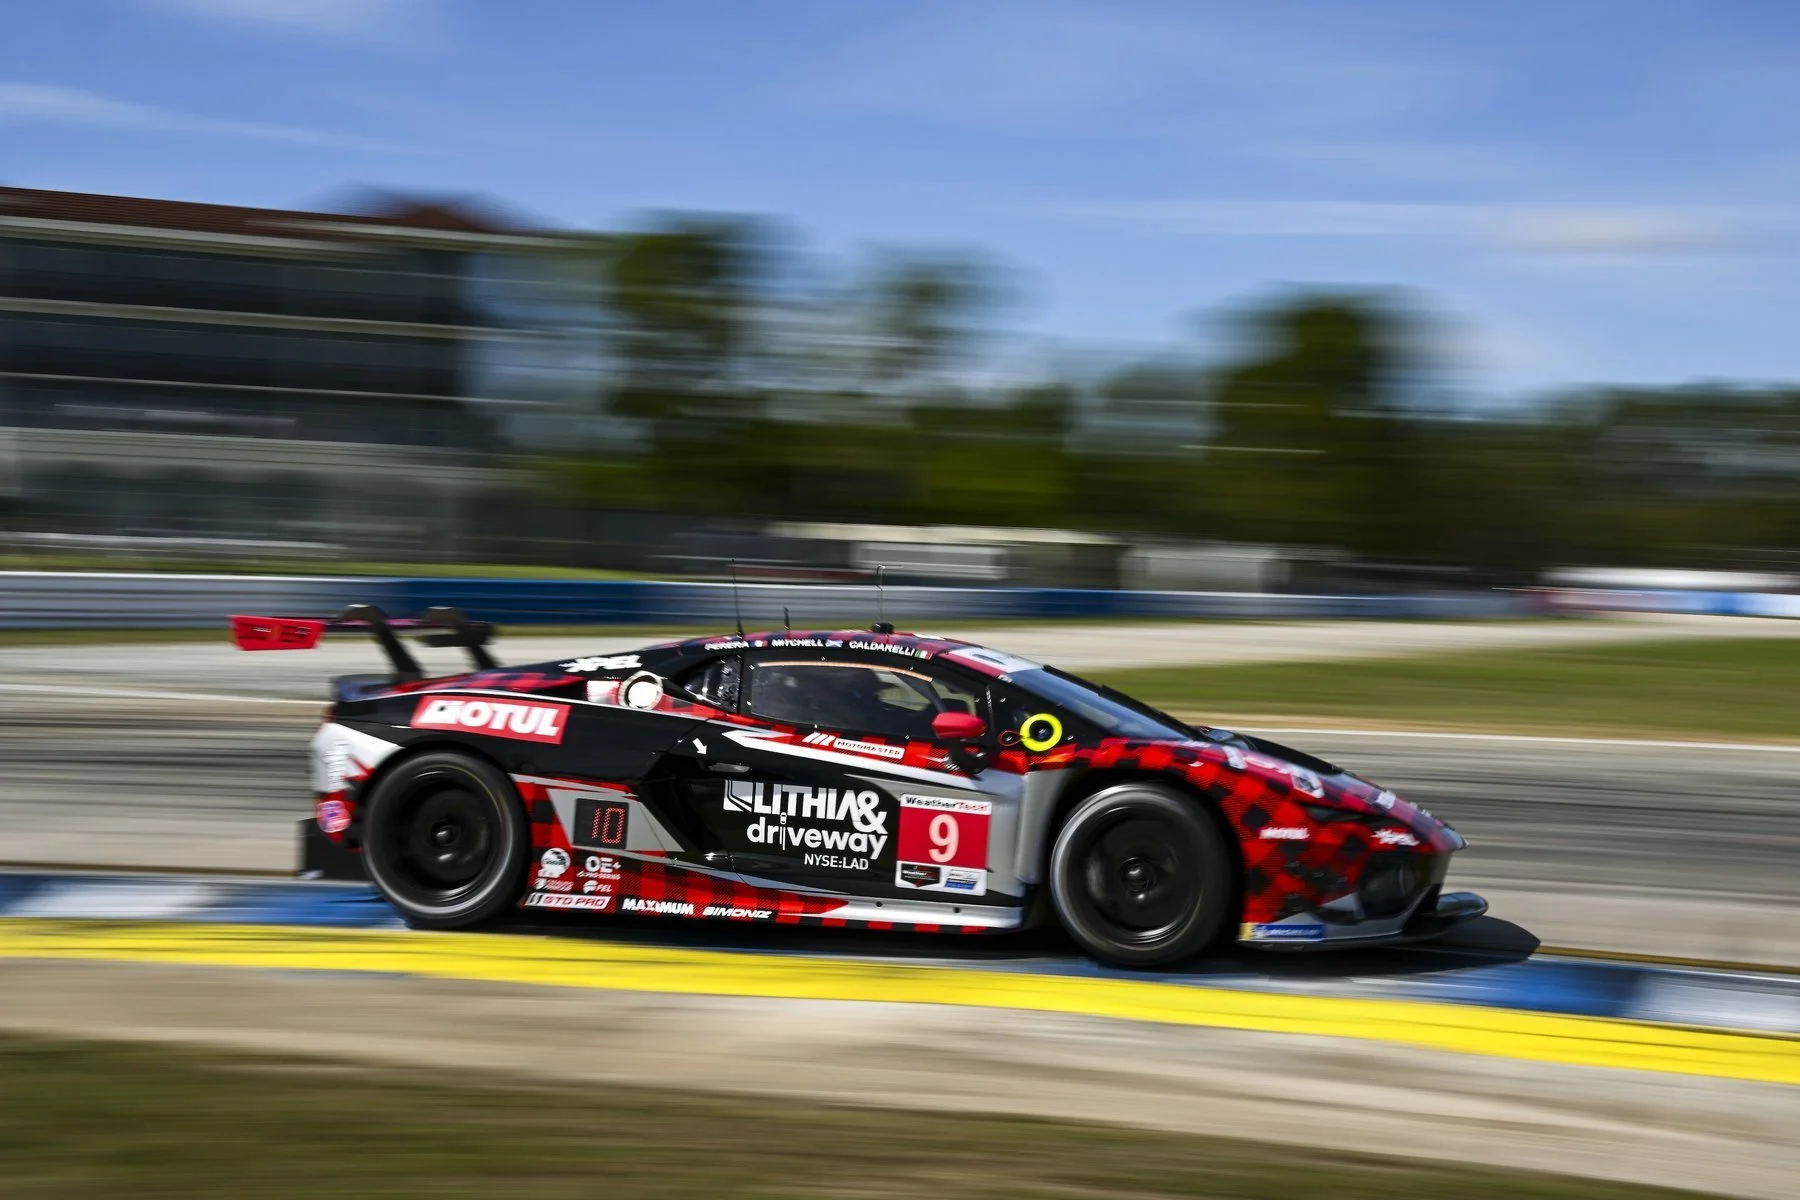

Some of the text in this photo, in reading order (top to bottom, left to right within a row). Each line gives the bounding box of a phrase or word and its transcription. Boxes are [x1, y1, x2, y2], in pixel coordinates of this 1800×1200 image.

[772, 639, 824, 647] MITCHELL
[849, 640, 914, 656] CALDARELLI
[418, 699, 559, 736] MOTUL
[837, 741, 901, 756] MOTOMASTER
[591, 807, 625, 844] 10
[746, 812, 889, 860] driveway
[928, 813, 960, 863] 9
[804, 853, 869, 870] NYSE:LAD
[573, 898, 605, 907] PRO
[622, 898, 694, 915] MAXIMUM
[702, 906, 773, 919] SIMONIZ
